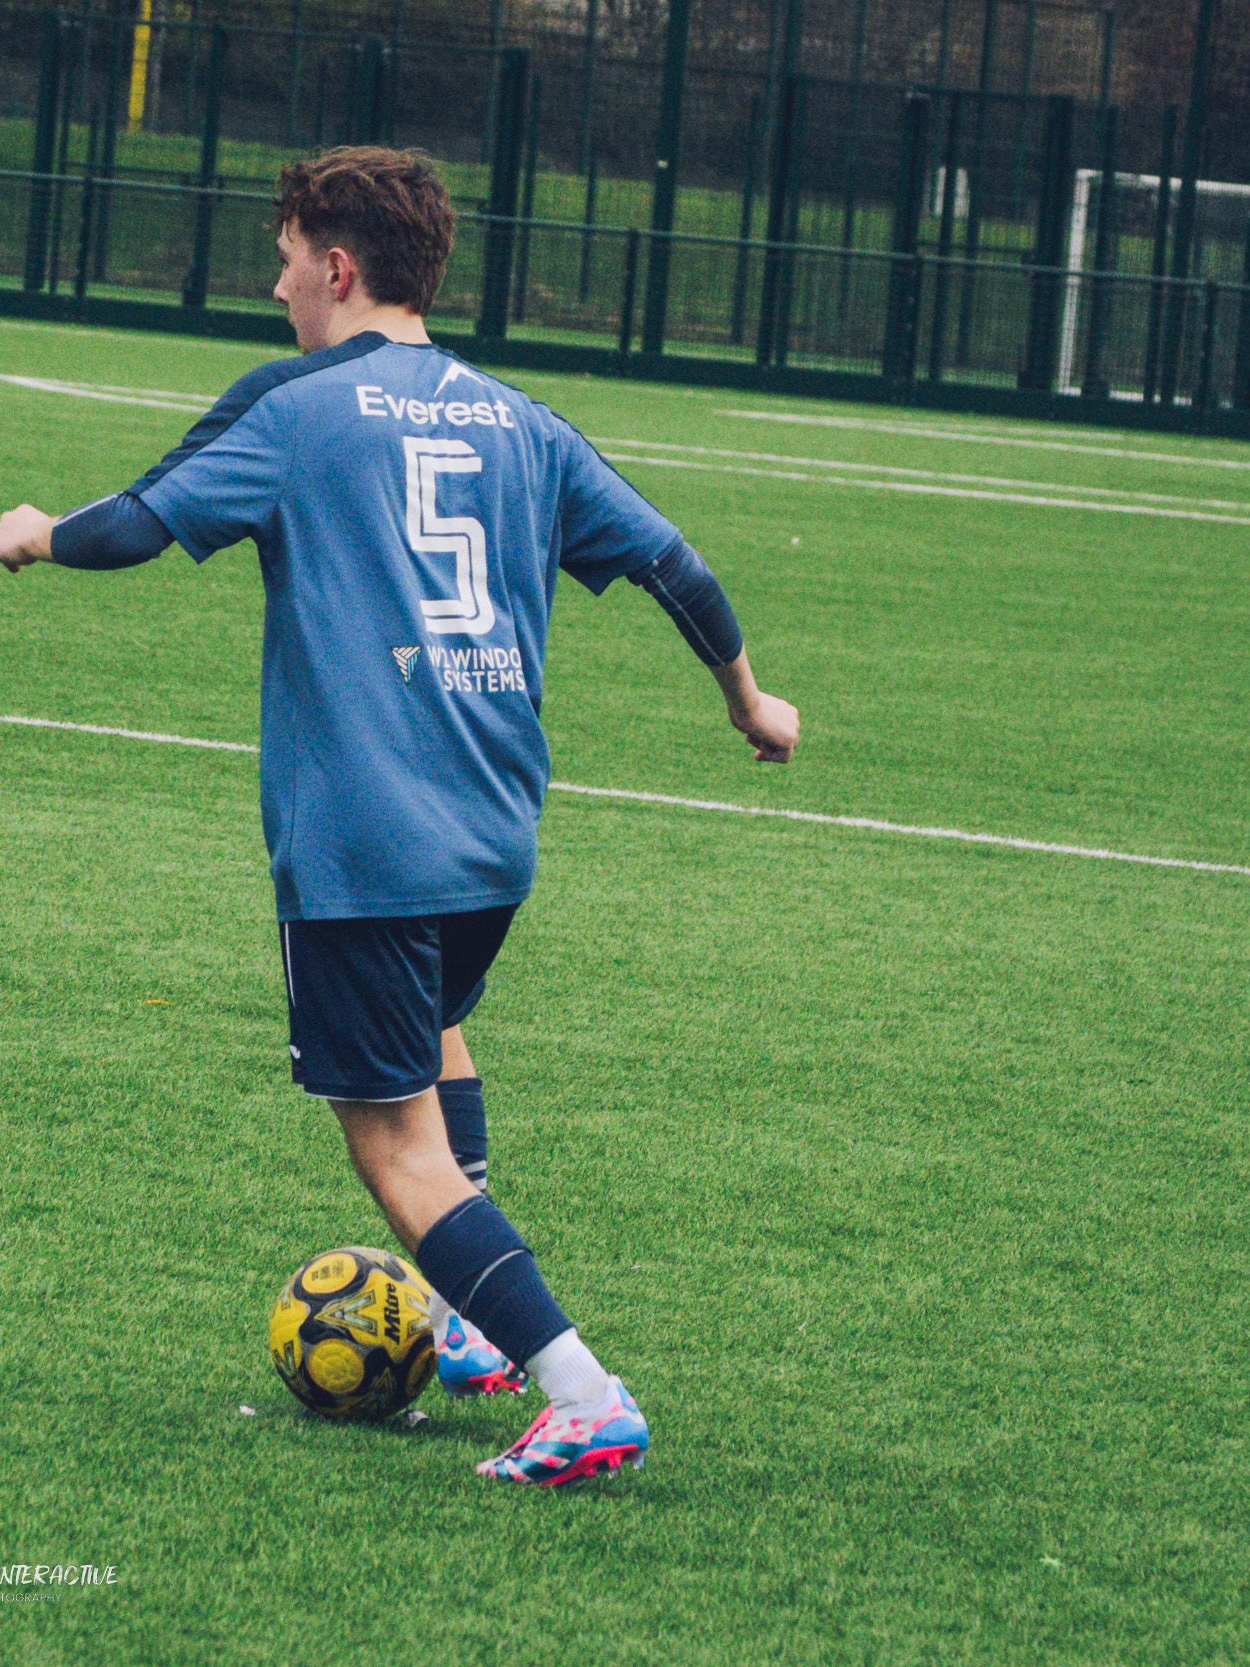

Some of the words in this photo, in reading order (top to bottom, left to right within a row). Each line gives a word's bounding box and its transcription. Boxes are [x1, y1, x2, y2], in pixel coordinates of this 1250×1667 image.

[355, 386, 515, 428] Everest
[403, 436, 496, 635] 5
[444, 669, 526, 692] SYSTEMS
[384, 1283, 401, 1346] Mitre
